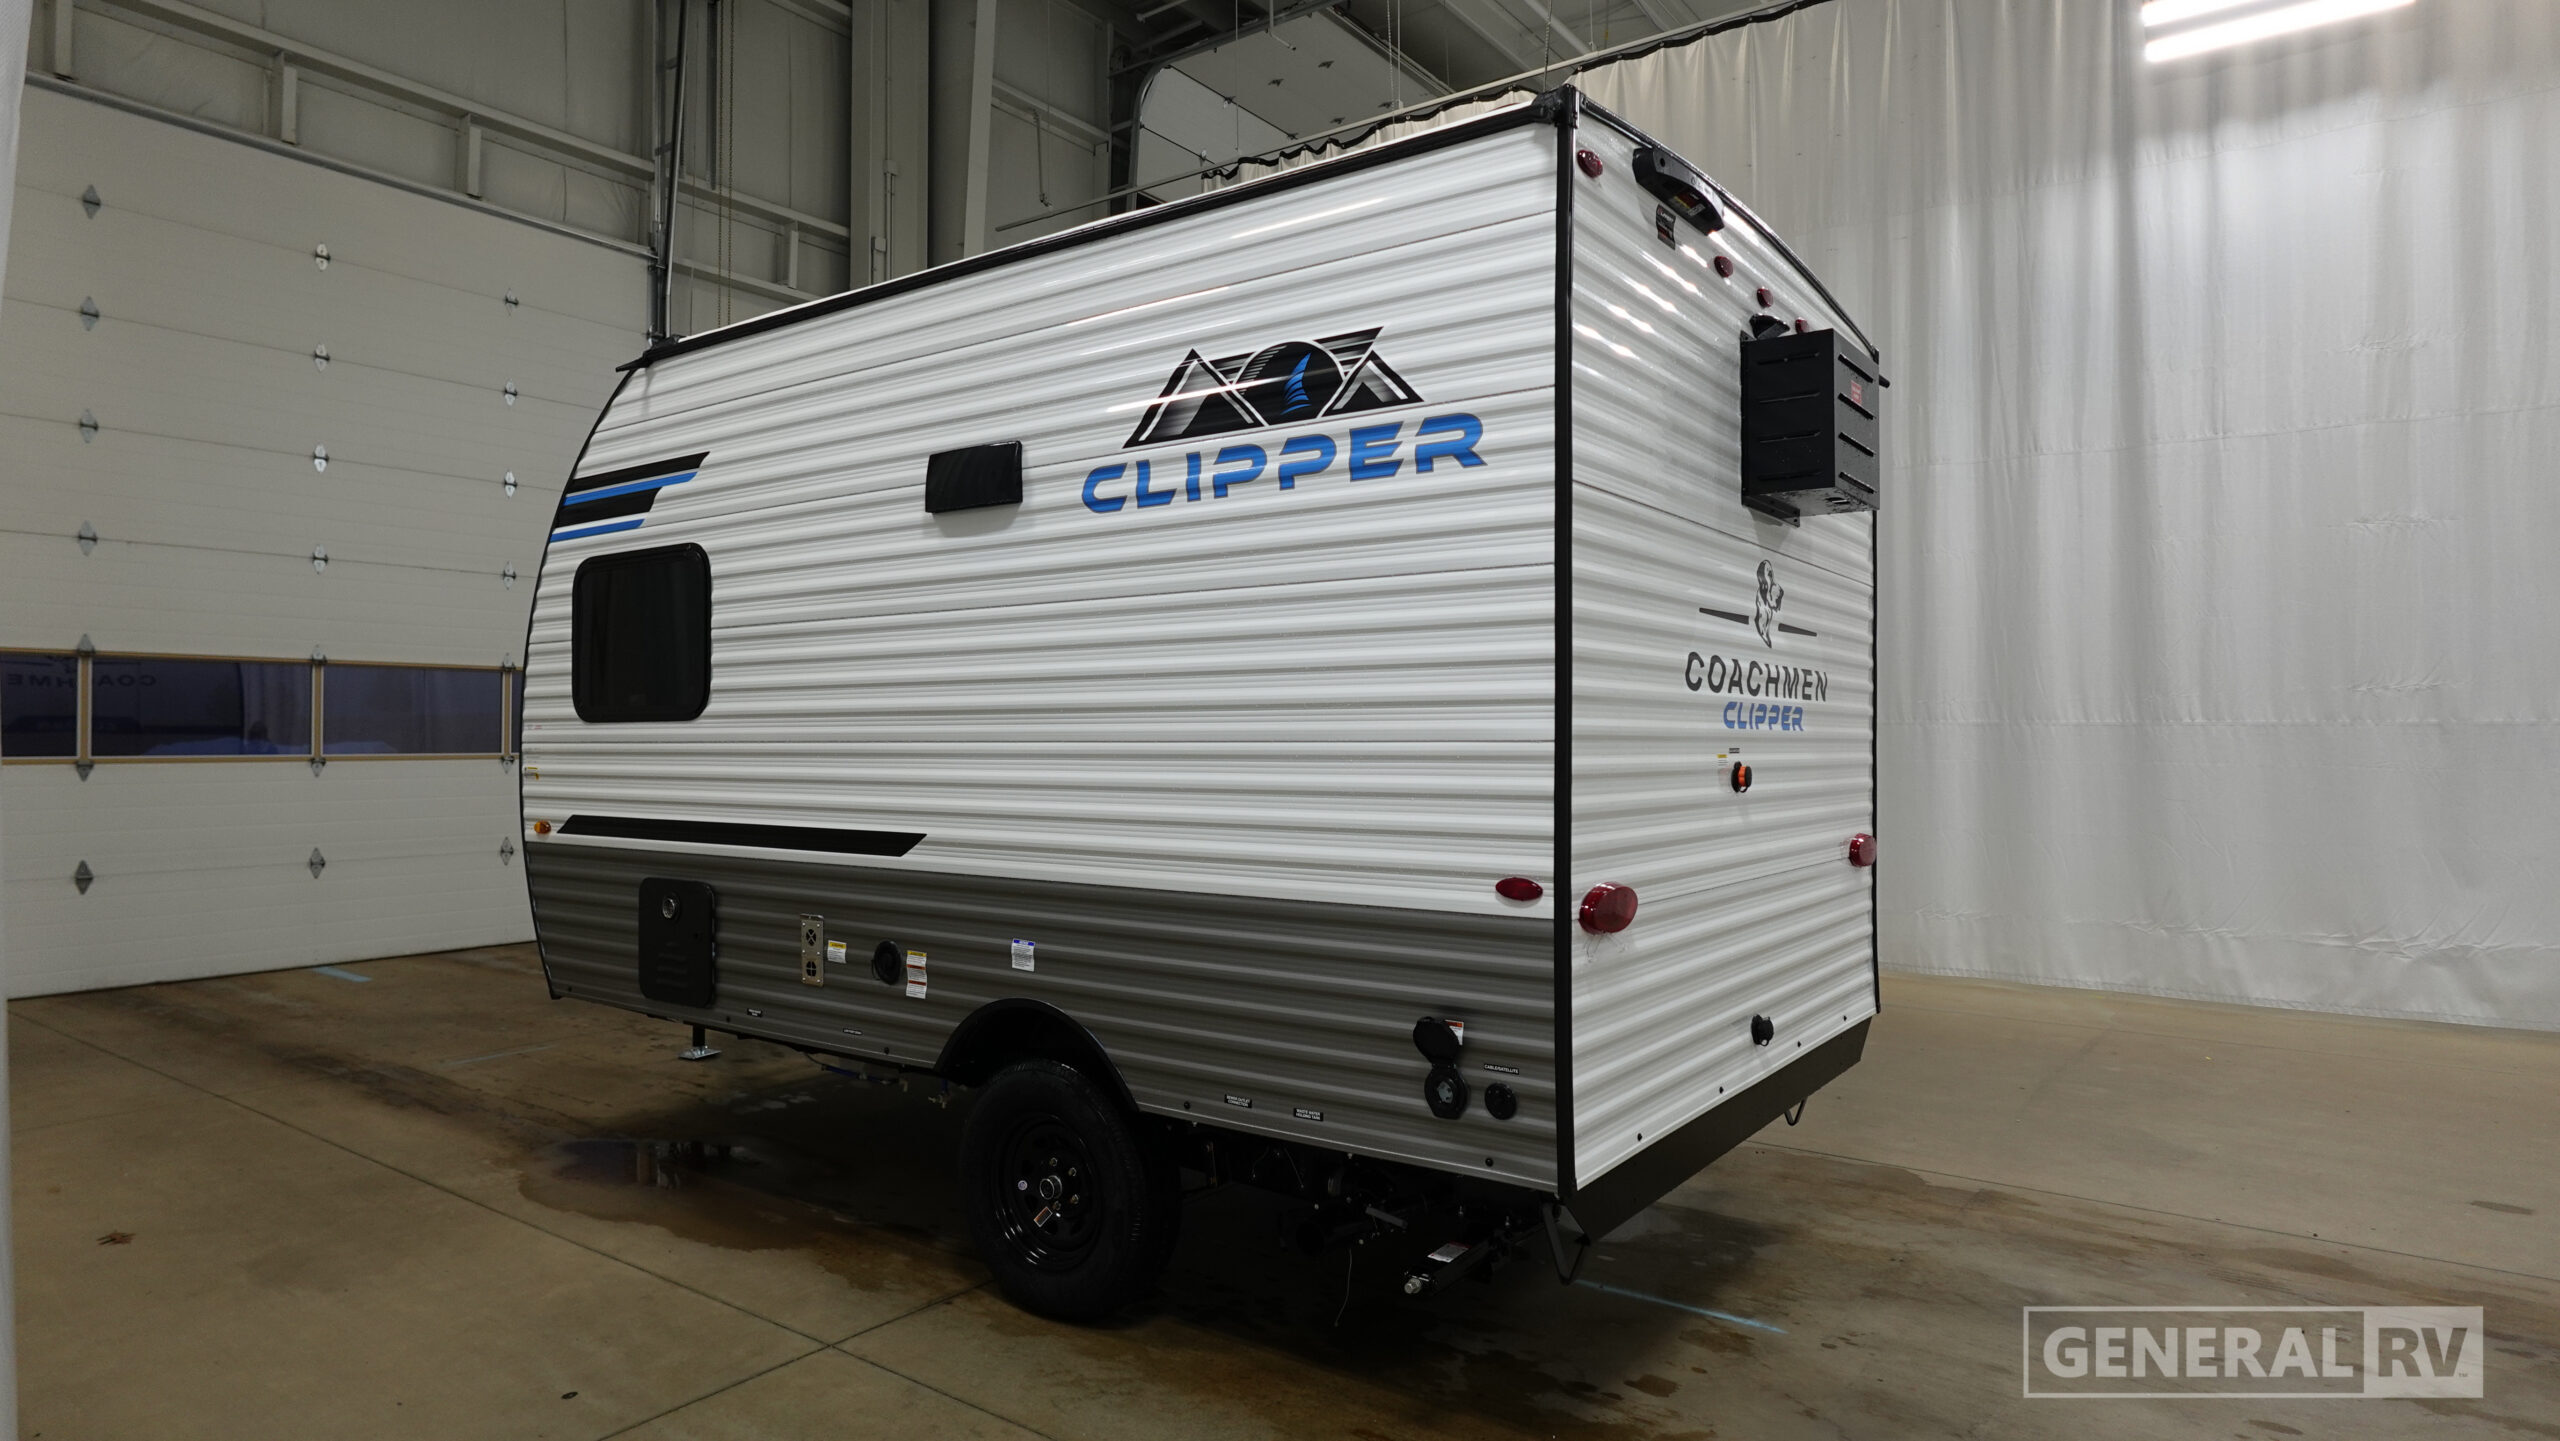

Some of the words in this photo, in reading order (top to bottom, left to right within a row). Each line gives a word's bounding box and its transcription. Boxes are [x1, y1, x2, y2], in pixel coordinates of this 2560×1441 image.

[1081, 412, 1488, 514] CLIPPER
[1684, 651, 1828, 702] COACHMEN
[1723, 701, 1804, 731] CLIPPER
